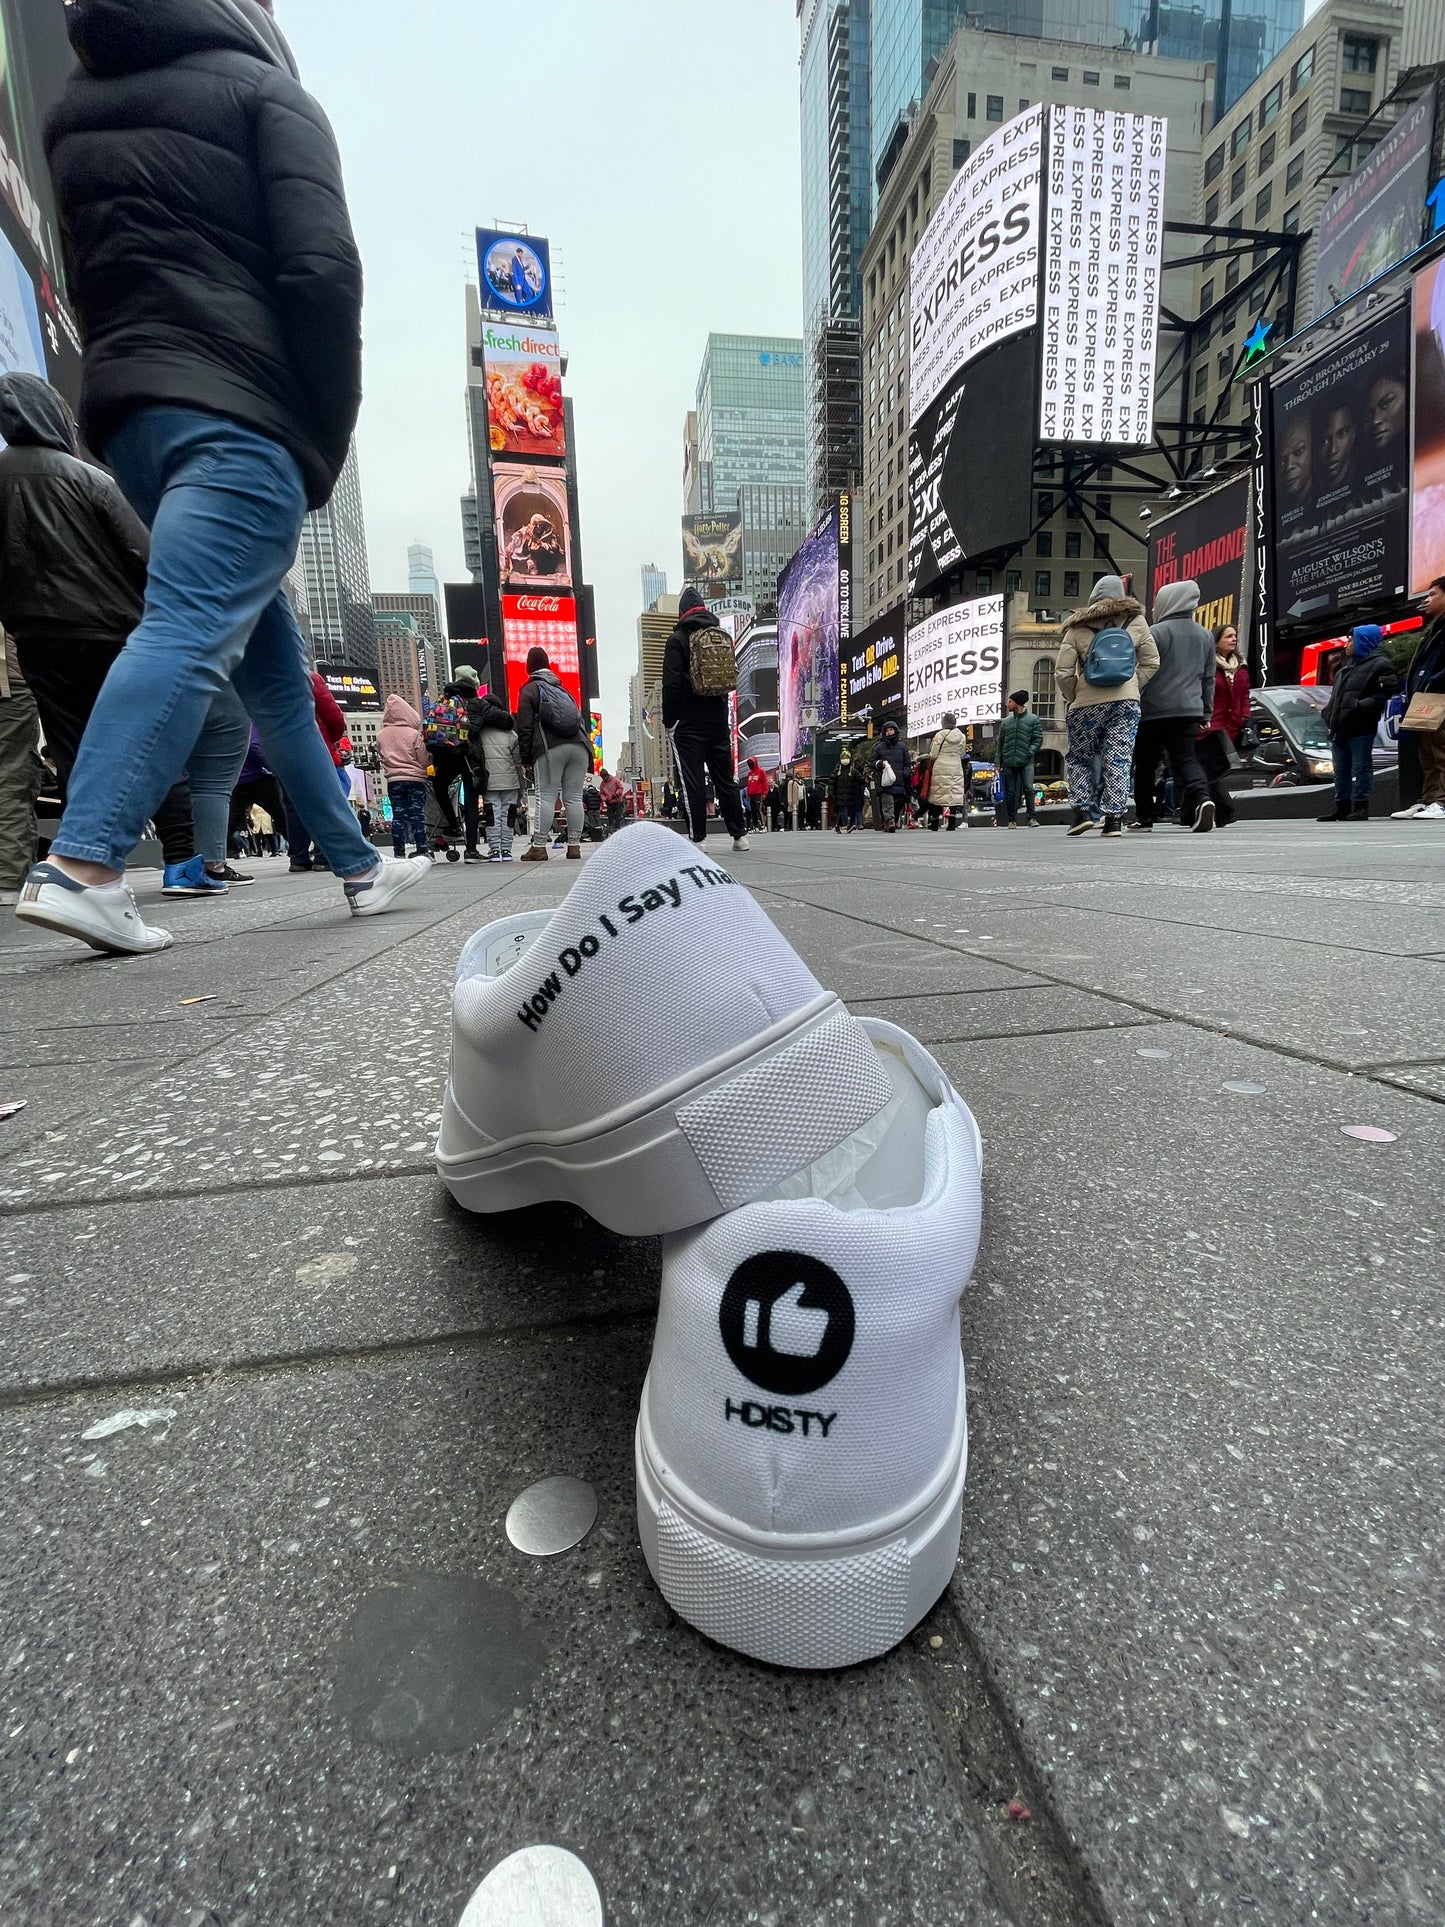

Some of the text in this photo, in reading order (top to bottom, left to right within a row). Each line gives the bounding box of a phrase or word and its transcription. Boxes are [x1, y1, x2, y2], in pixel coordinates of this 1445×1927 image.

[933, 197, 966, 257] EXPRESS
[972, 142, 1040, 199] EXPRESS
[948, 144, 994, 207] EXPRESS
[948, 199, 993, 258] EXPRESS
[913, 203, 1031, 351] EXPRESS
[933, 293, 965, 344] EXPRESS
[970, 246, 1037, 296] EXPRESS
[1044, 104, 1066, 438] EXPRESS EXPRESS EXPRESS EXP
[1063, 109, 1086, 441] ESS EXPRESS EXPRESS EXPRESS
[1082, 108, 1105, 439] EXPRESS EXPRESS EXPRESS EXP
[1101, 114, 1125, 442] ESS EXPRESS EXPRESS EXPRESS
[1119, 115, 1144, 441] EXPRESS EXPRESS EXPRESS EXP
[1136, 119, 1163, 443] ESS EXPRESS EXPRESS EXPRESS
[486, 329, 560, 357] freshdirect
[917, 346, 943, 390] EXPRESS
[947, 298, 991, 349] EXPRESS
[932, 345, 964, 390] EXPRESS
[969, 304, 1035, 349] EXPRESS
[1300, 341, 1370, 390] ON BROADWAY
[1283, 379, 1329, 411] THROUGH
[1332, 347, 1378, 385] JANUARY
[840, 507, 849, 544] SCREEN
[1156, 531, 1177, 565] THE
[840, 570, 849, 583] GO
[1154, 559, 1178, 593] NEIL
[1182, 526, 1247, 581] DIAMOND
[1289, 574, 1309, 587] THE
[1311, 563, 1342, 580] PIANO
[1344, 546, 1385, 568] LESSON
[1291, 557, 1330, 579] AUGUST
[1332, 538, 1383, 562] WILSON'S
[1338, 583, 1352, 593] ONE
[1352, 576, 1373, 588] BLOCK
[1373, 573, 1383, 582] UP
[708, 599, 752, 612] ITTLE SHOP
[840, 586, 849, 597] TO
[927, 608, 970, 634] EXPRESS
[852, 636, 896, 673] Text OR Drive.
[908, 646, 999, 695] EXPRESS
[915, 637, 942, 661] EXPRESS
[849, 676, 866, 695] There
[866, 670, 873, 687] Is
[872, 665, 882, 683] No
[913, 693, 942, 713] EXPRESS
[517, 971, 562, 1032] How
[558, 935, 600, 976] Do
[599, 914, 618, 937] I
[618, 878, 682, 923] Say
[678, 865, 739, 889] Tha
